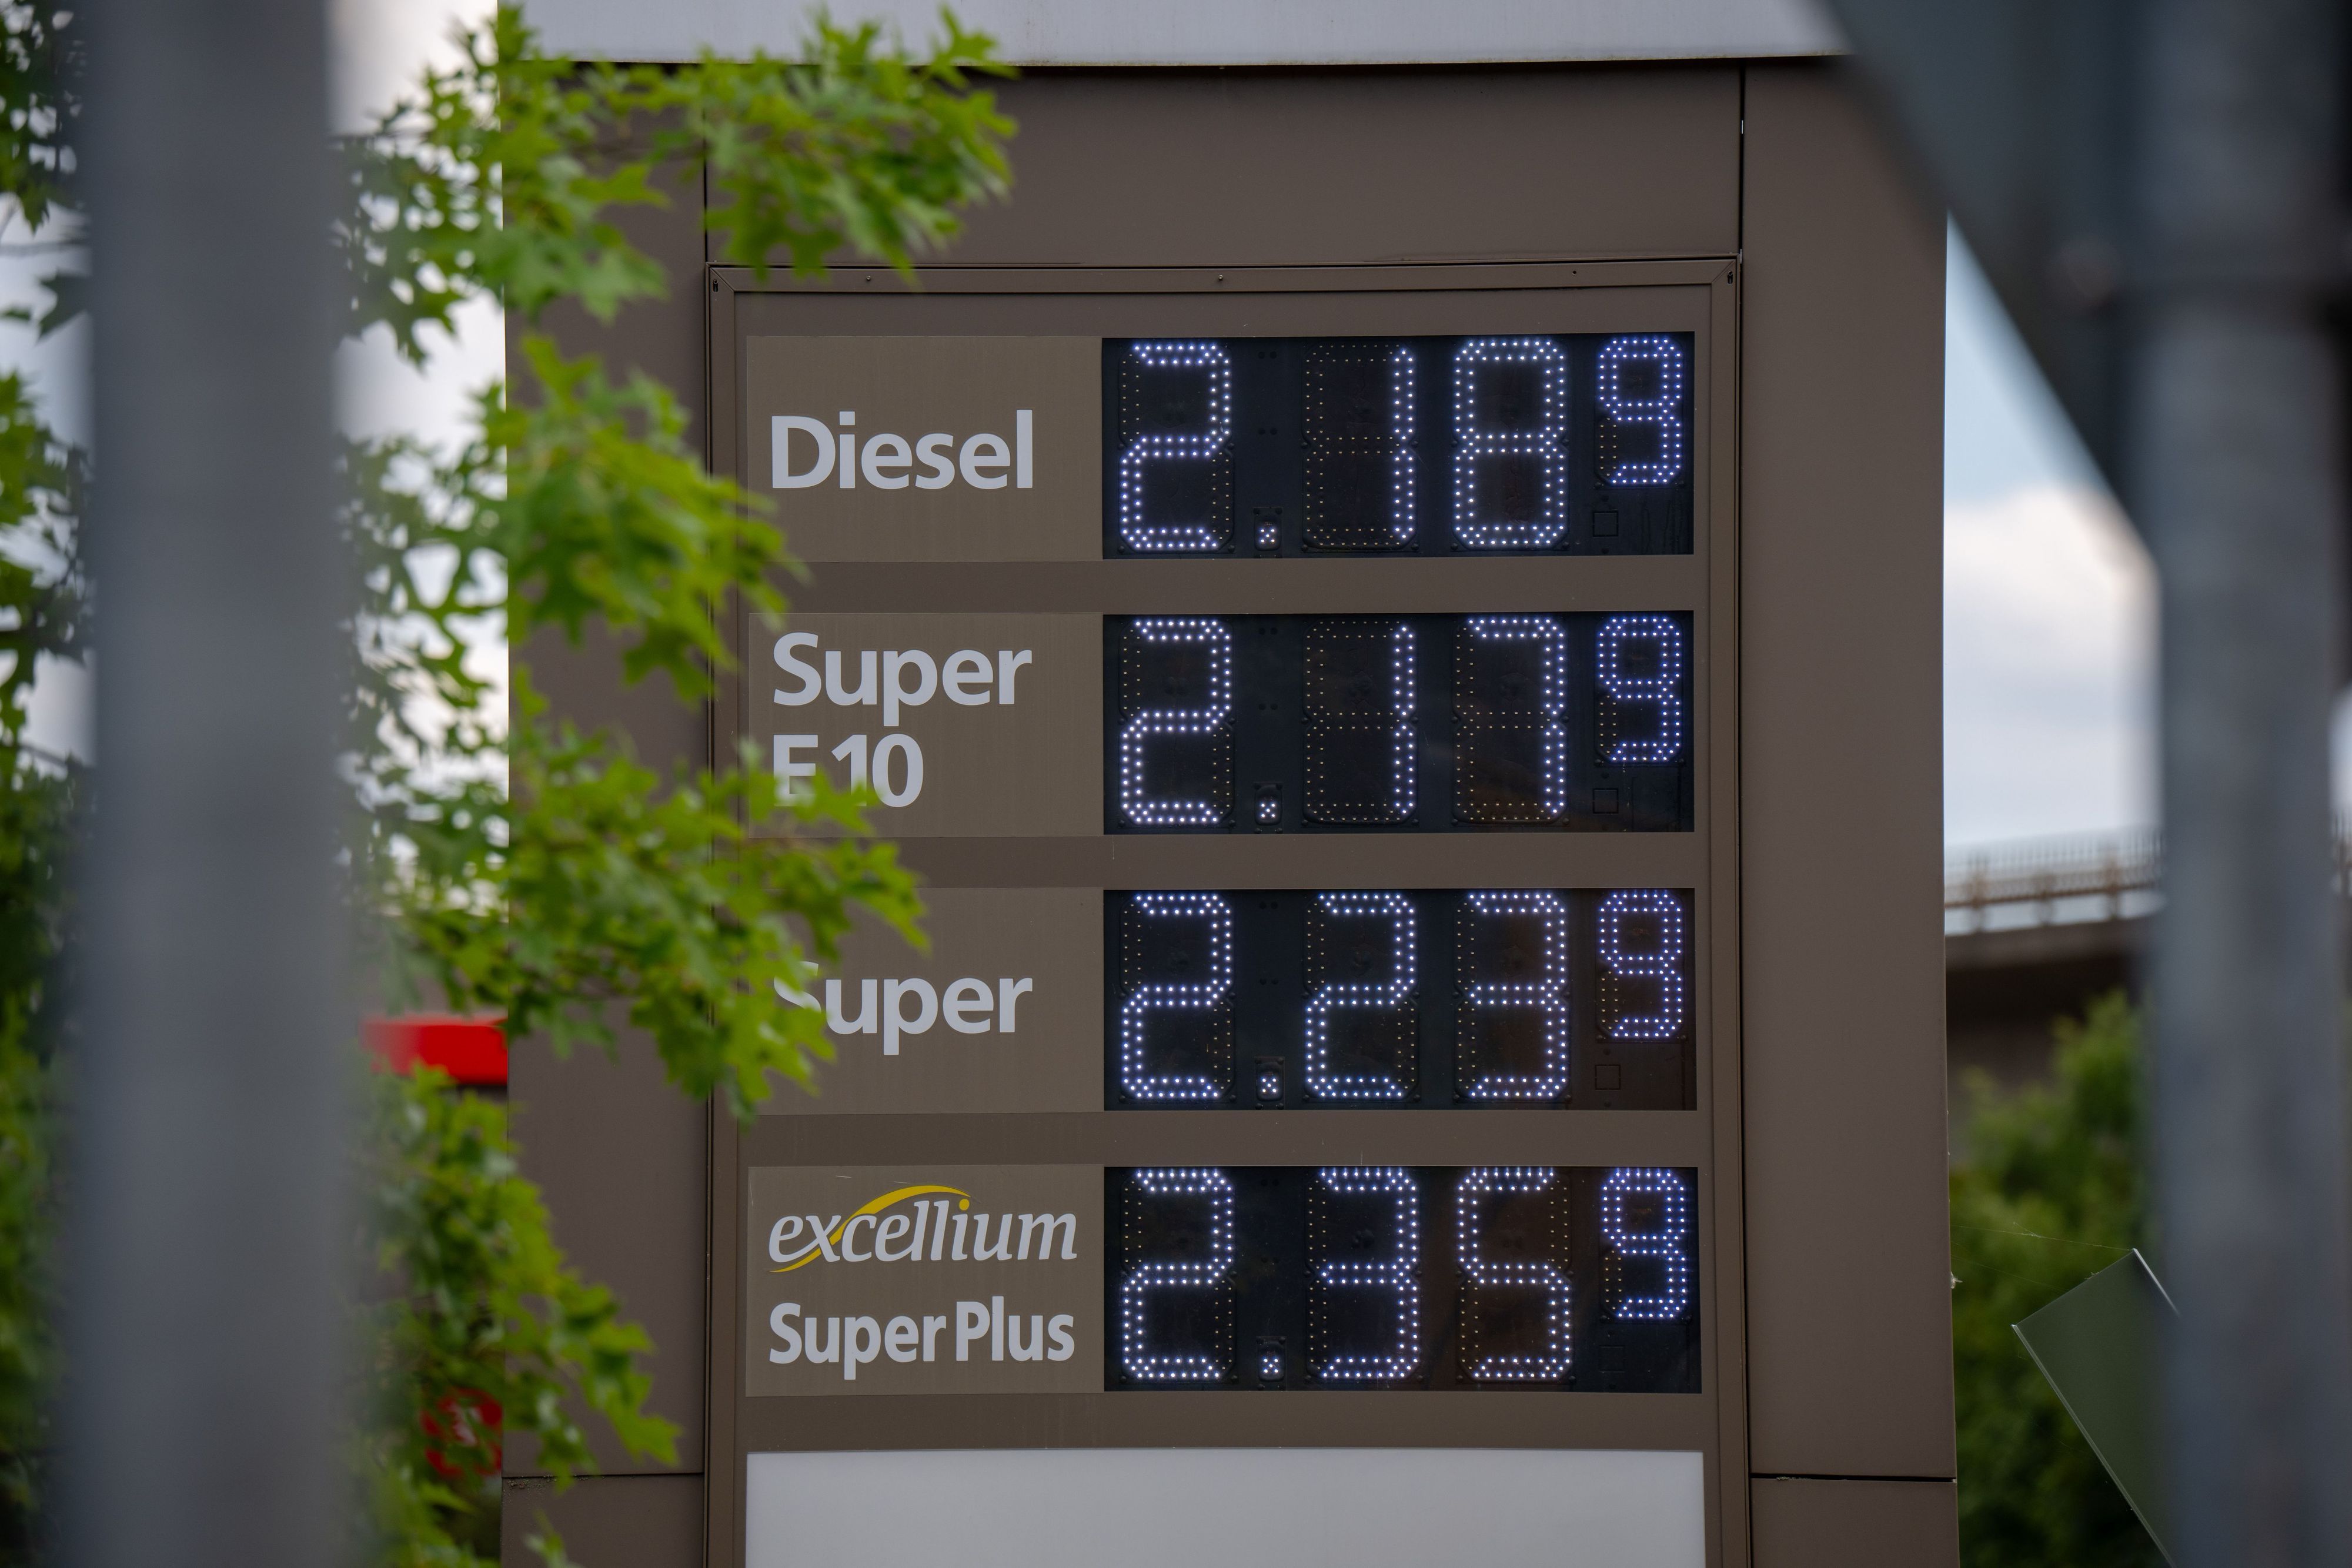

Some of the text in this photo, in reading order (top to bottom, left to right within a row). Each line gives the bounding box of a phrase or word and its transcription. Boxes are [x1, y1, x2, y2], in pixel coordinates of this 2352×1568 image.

[771, 409, 1034, 490] Diesel
[773, 632, 1033, 727] Super
[773, 733, 924, 808] E 10
[768, 1199, 1077, 1263] excellium
